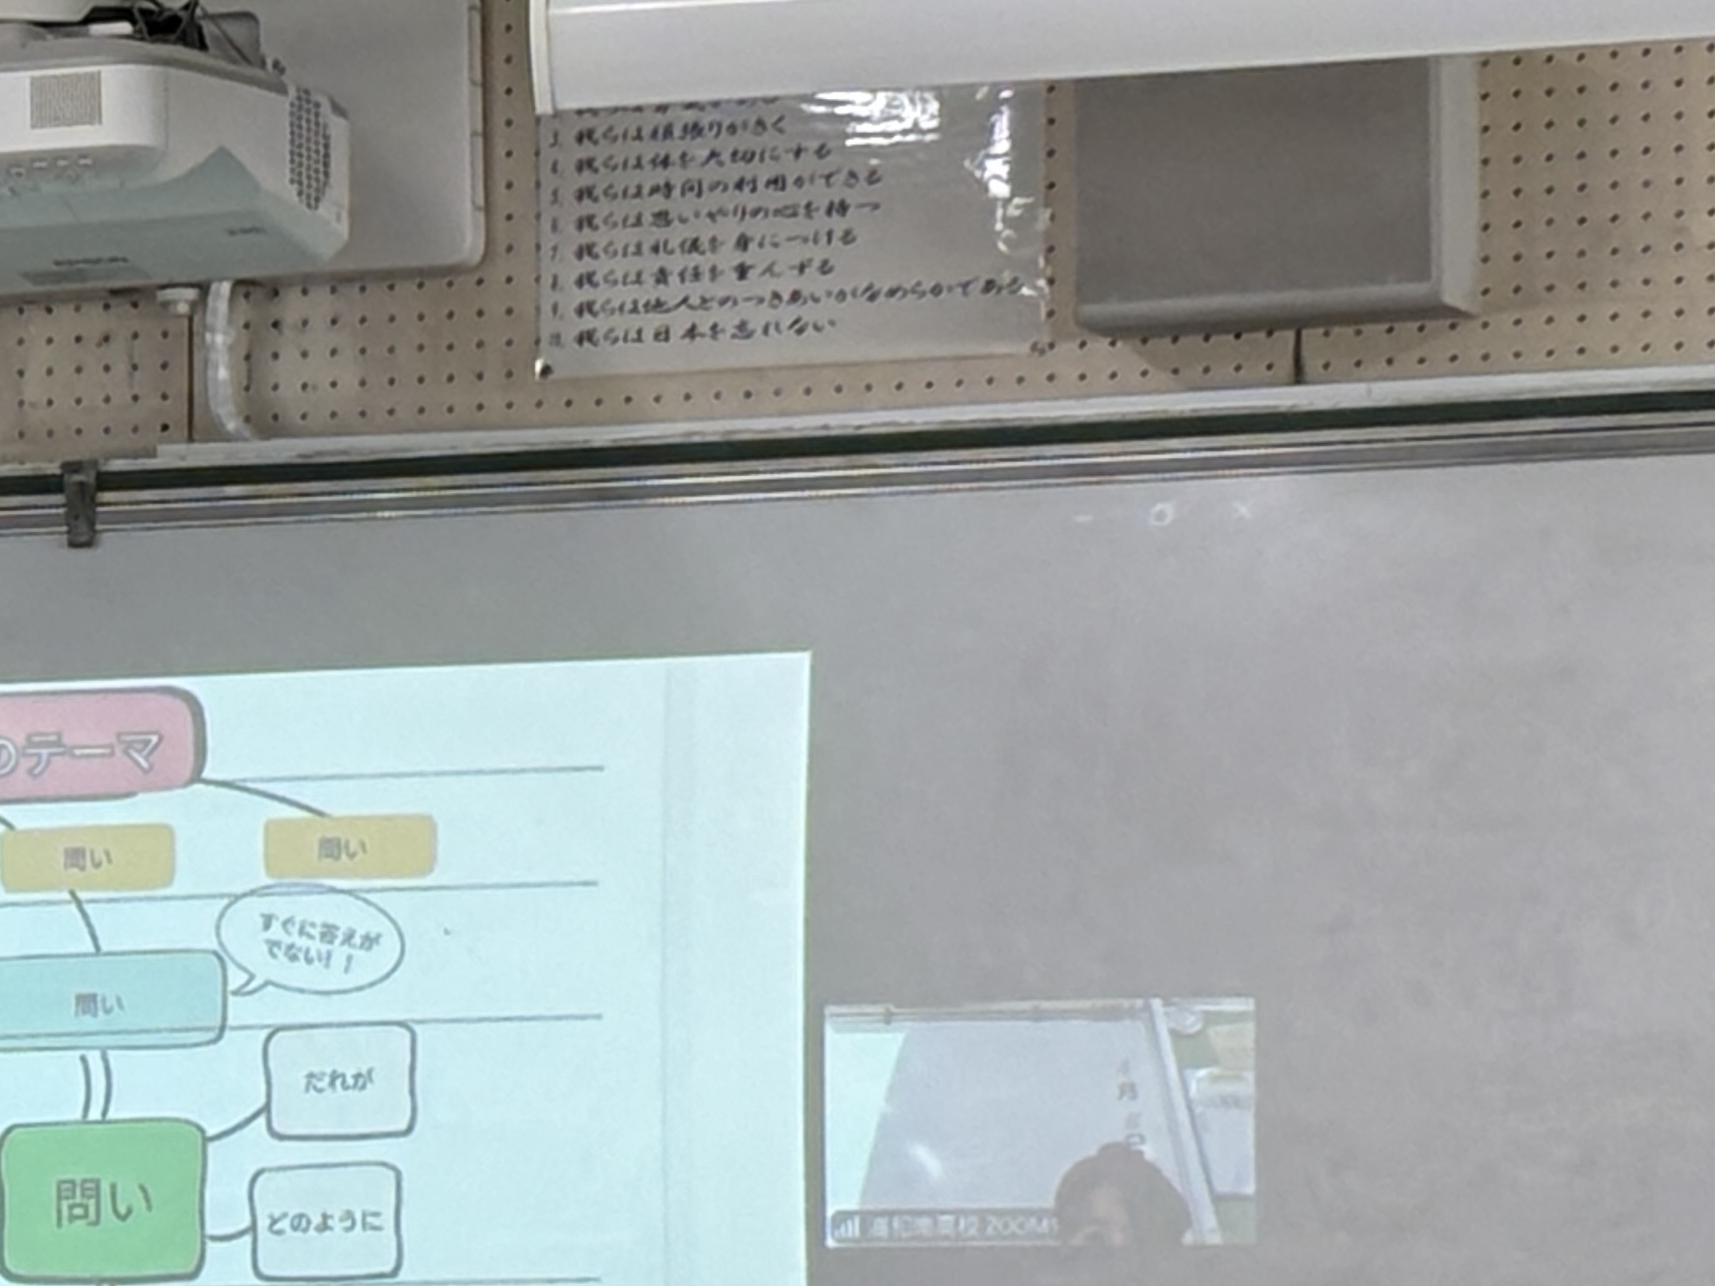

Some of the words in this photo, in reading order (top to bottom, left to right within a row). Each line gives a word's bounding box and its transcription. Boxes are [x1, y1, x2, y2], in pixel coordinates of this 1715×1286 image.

[62, 846, 113, 872] 問い
[317, 836, 368, 862] 問い
[257, 909, 383, 951] すぐに答えが
[73, 990, 125, 1019] 問い
[302, 1067, 374, 1094] だれが
[54, 1176, 154, 1230] 問い
[265, 1207, 384, 1236] どのように
